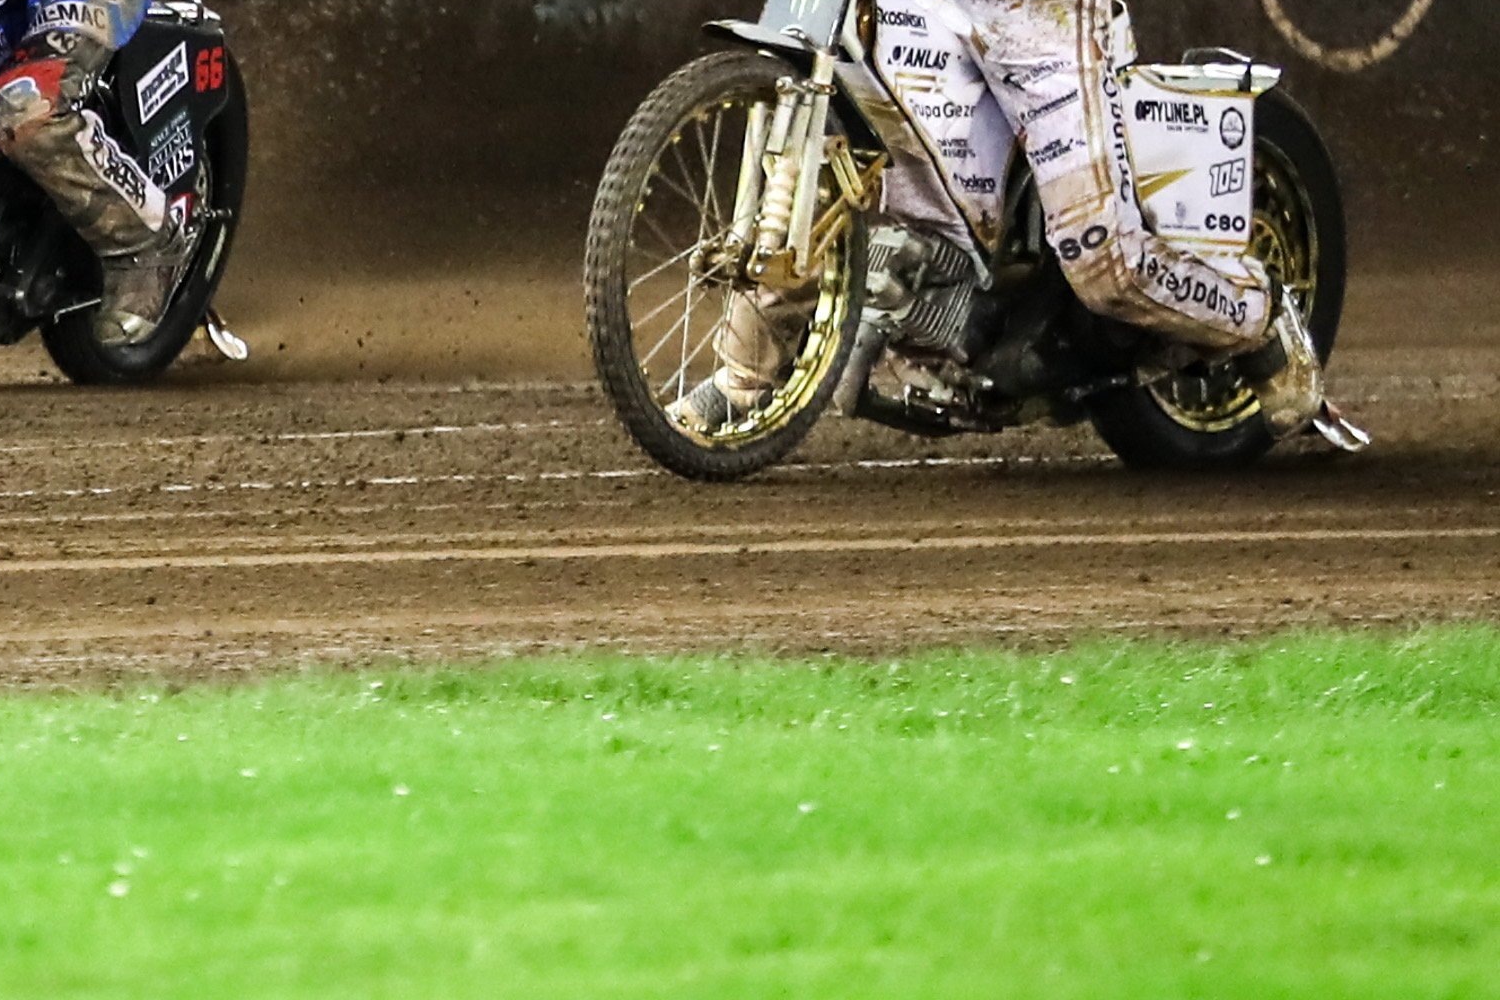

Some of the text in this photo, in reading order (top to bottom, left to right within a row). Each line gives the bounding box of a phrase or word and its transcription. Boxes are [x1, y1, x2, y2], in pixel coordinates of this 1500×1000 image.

[196, 46, 224, 93] 66
[903, 47, 952, 70] ANLAS
[1135, 99, 1209, 126] OPTYLINE.PL
[1209, 157, 1245, 198] 105
